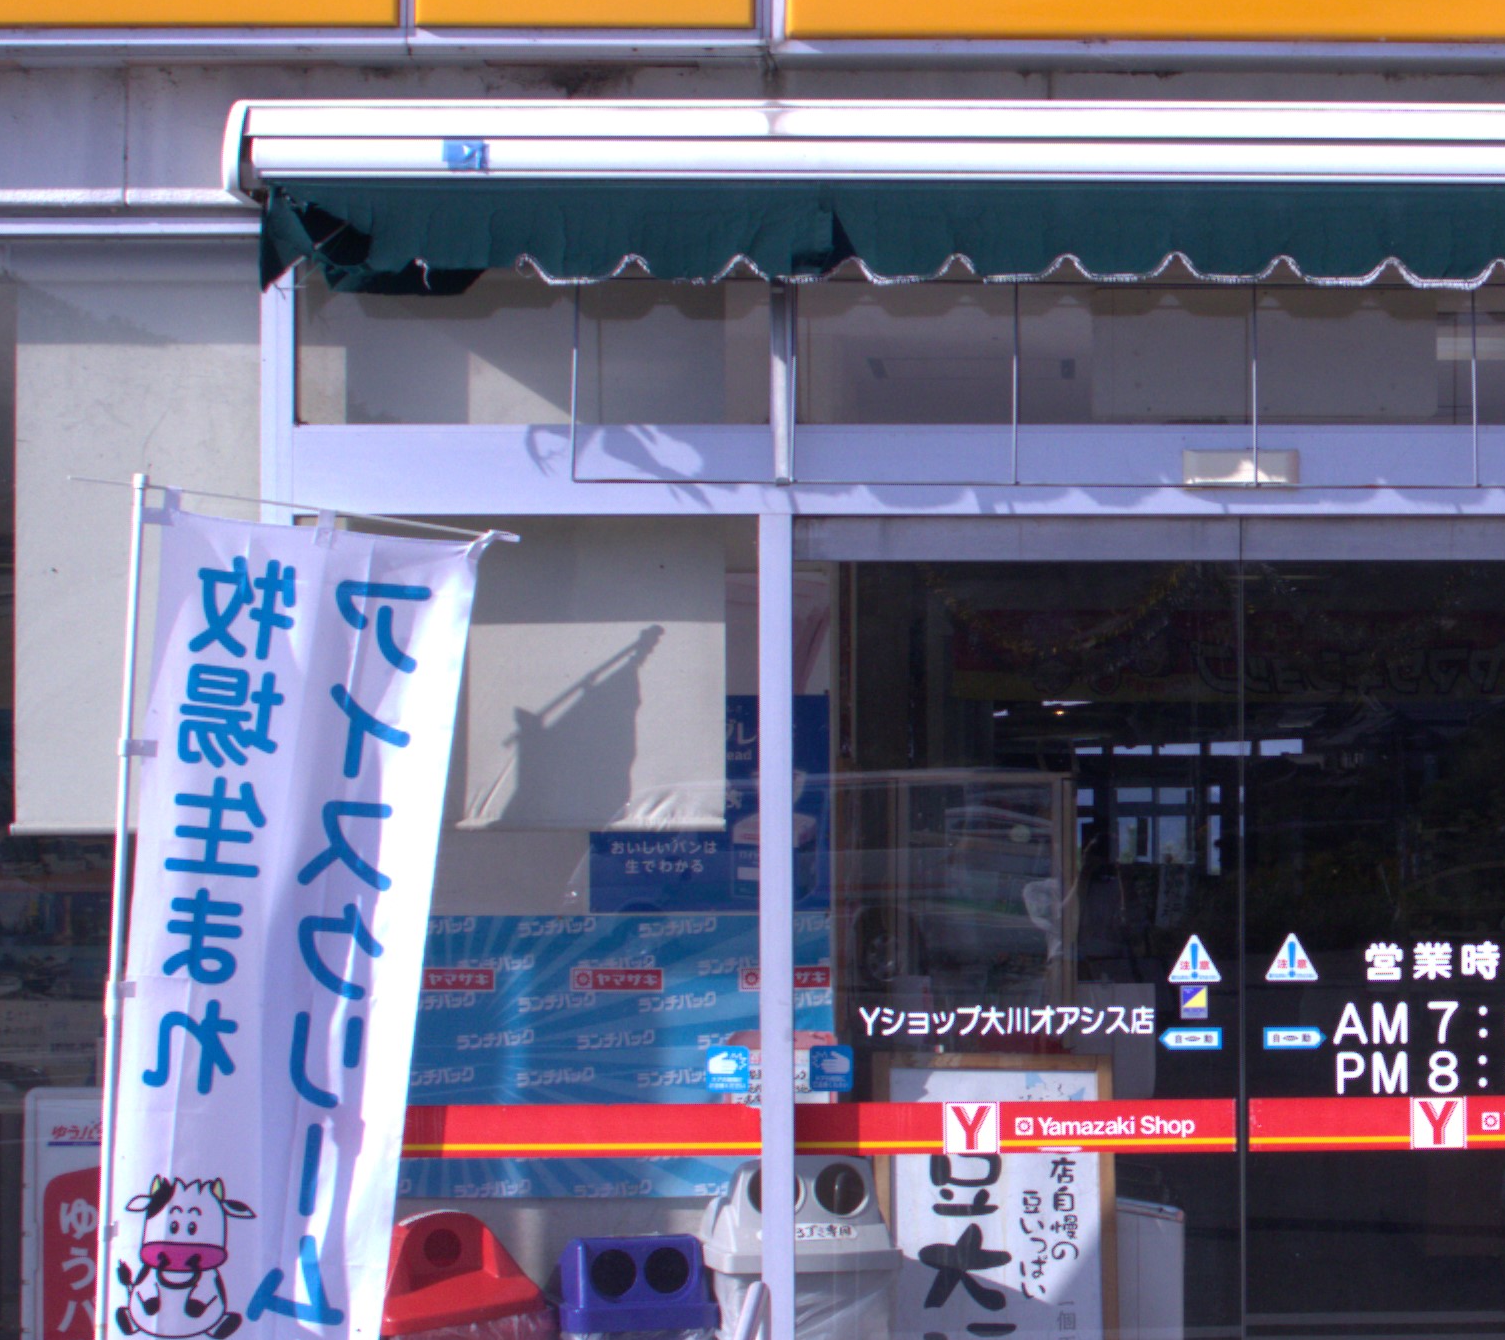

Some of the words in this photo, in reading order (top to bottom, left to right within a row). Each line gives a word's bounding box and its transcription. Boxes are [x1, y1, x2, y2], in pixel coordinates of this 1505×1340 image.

[428, 972, 490, 987] ヤマザキ
[595, 972, 658, 987] ヤマザキ
[795, 968, 827, 984] ザキ
[859, 1005, 1155, 1036] Yショップ大川オアシス店
[1333, 1001, 1409, 1045] AM
[1336, 1051, 1409, 1095] PM
[950, 1105, 992, 1150] Y
[1038, 1116, 1135, 1136] Yamazaki
[1140, 1114, 1196, 1139] Shop
[1418, 1101, 1461, 1145] Y
